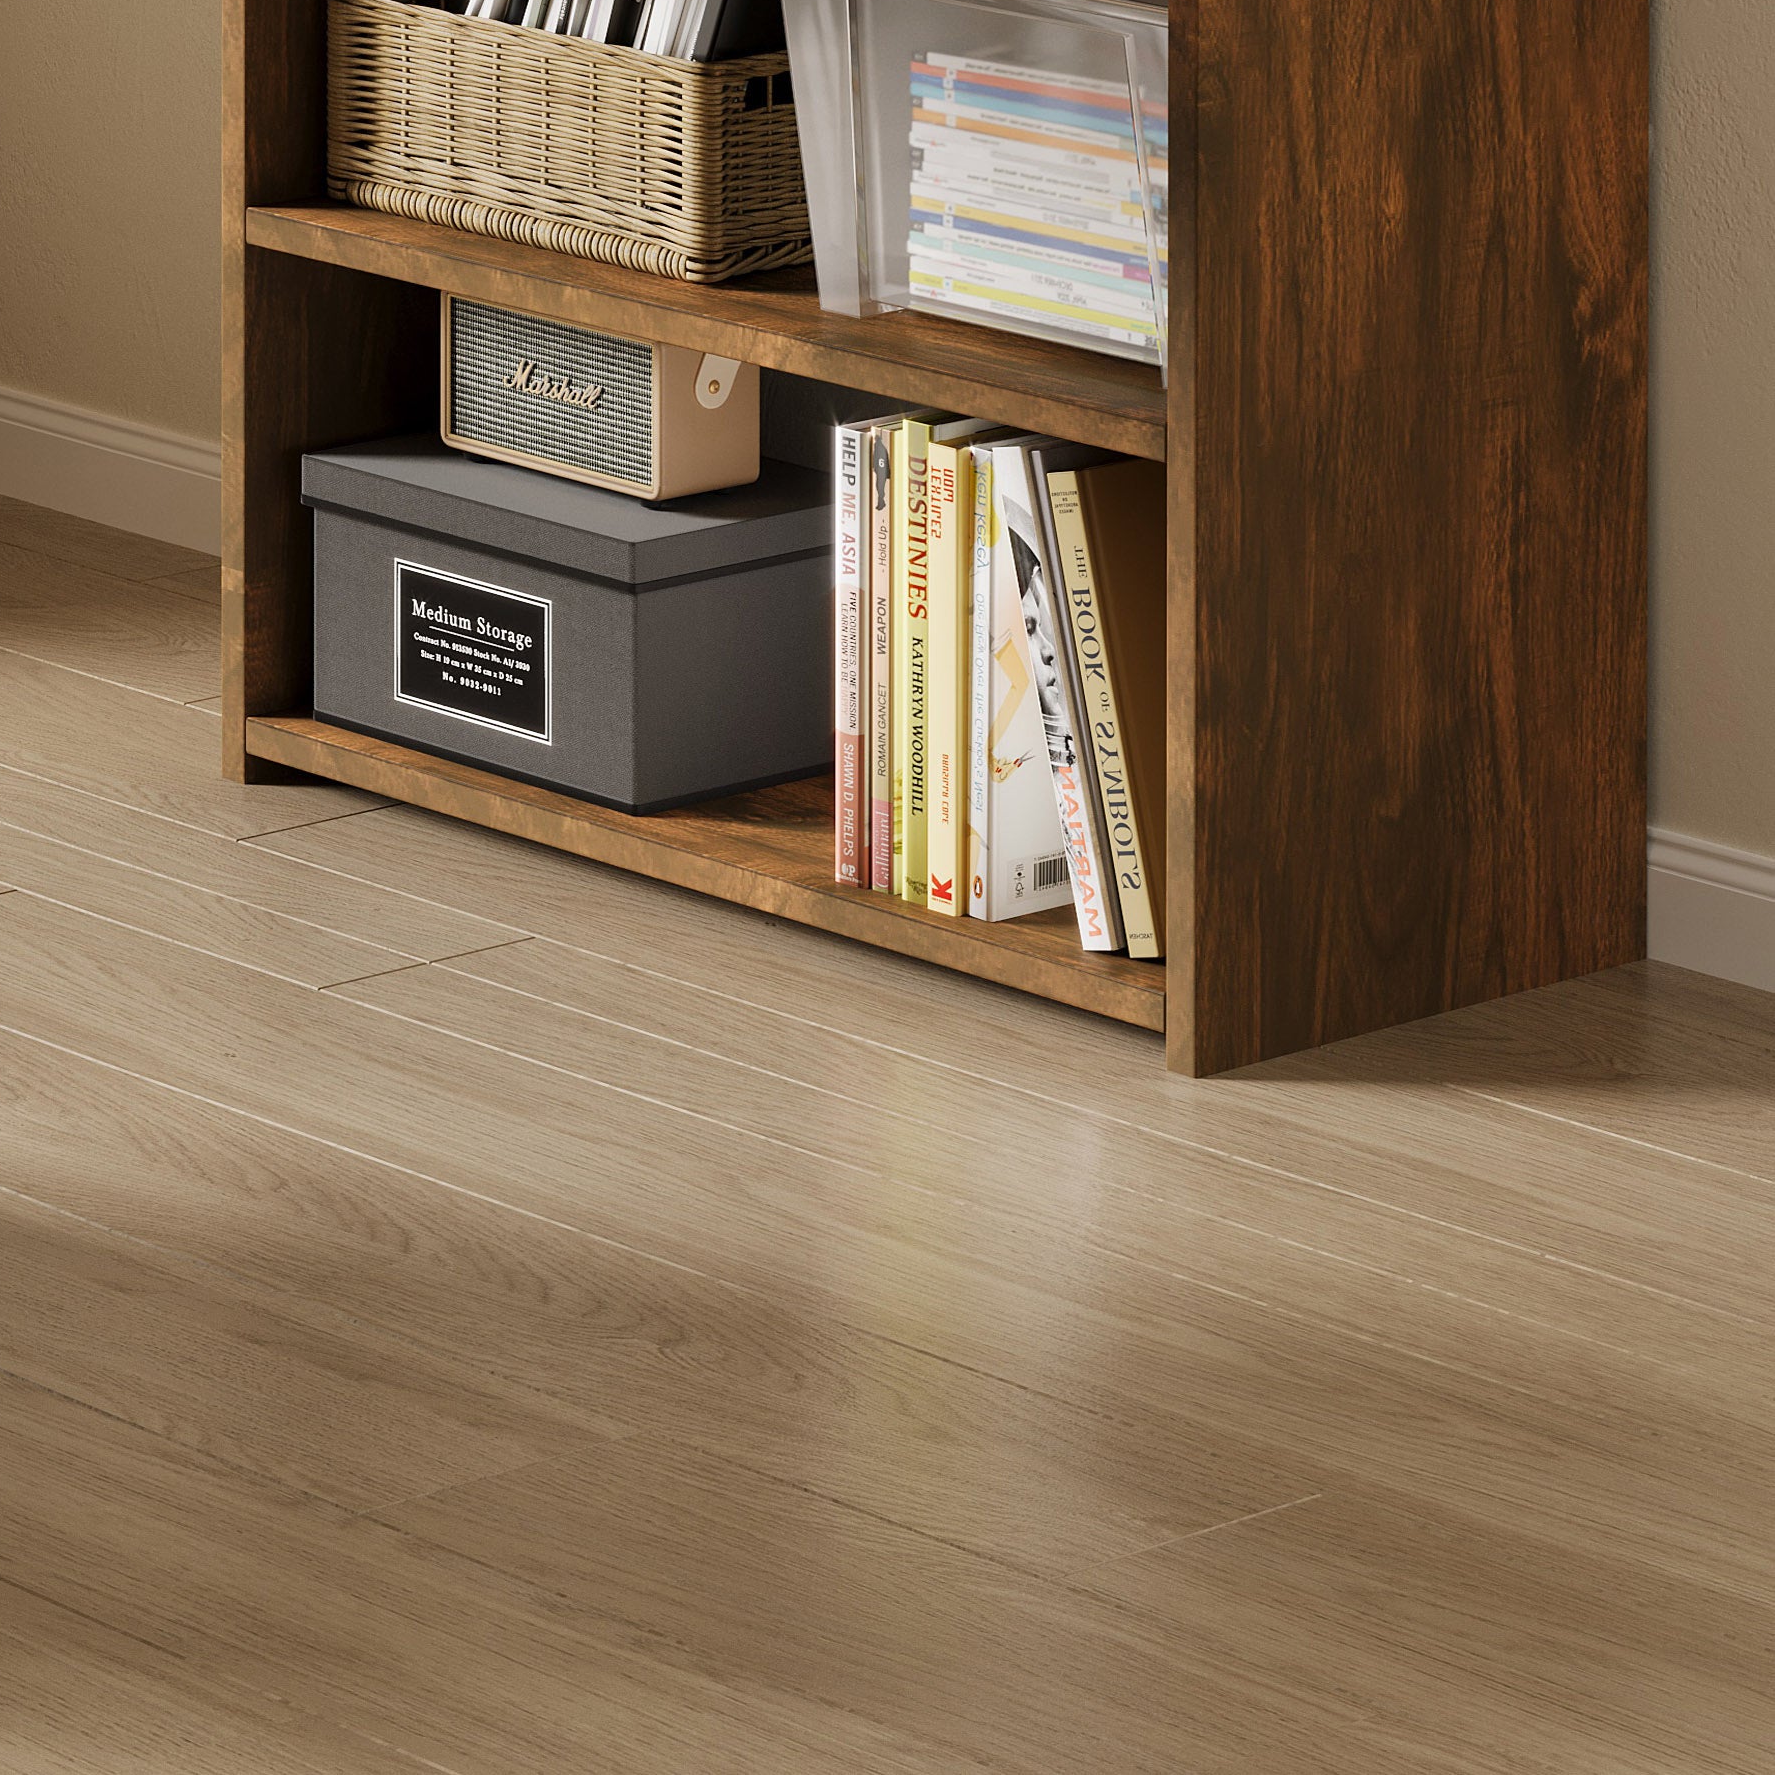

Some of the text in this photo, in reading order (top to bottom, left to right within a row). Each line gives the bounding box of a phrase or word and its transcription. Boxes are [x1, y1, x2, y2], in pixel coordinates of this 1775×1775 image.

[503, 359, 606, 410] Marshall
[841, 435, 856, 575] HELP ME, ASIA
[879, 525, 889, 566] Hold Up
[908, 454, 928, 620] DESTINIES
[411, 599, 533, 651] Medium Storage
[840, 603, 848, 632] LEARN
[849, 591, 857, 612] FIVE
[877, 597, 886, 655] WEAPON
[440, 639, 451, 649] No.
[491, 654, 502, 664] No.
[442, 671, 457, 683] No.
[849, 670, 857, 689] ONE
[878, 683, 887, 777] ROMAIN GANCET
[912, 637, 924, 816] KATHRYN WOODHILL
[842, 743, 854, 789] SHAWN
[842, 790, 854, 803] D.
[842, 808, 854, 857] PHELPS
